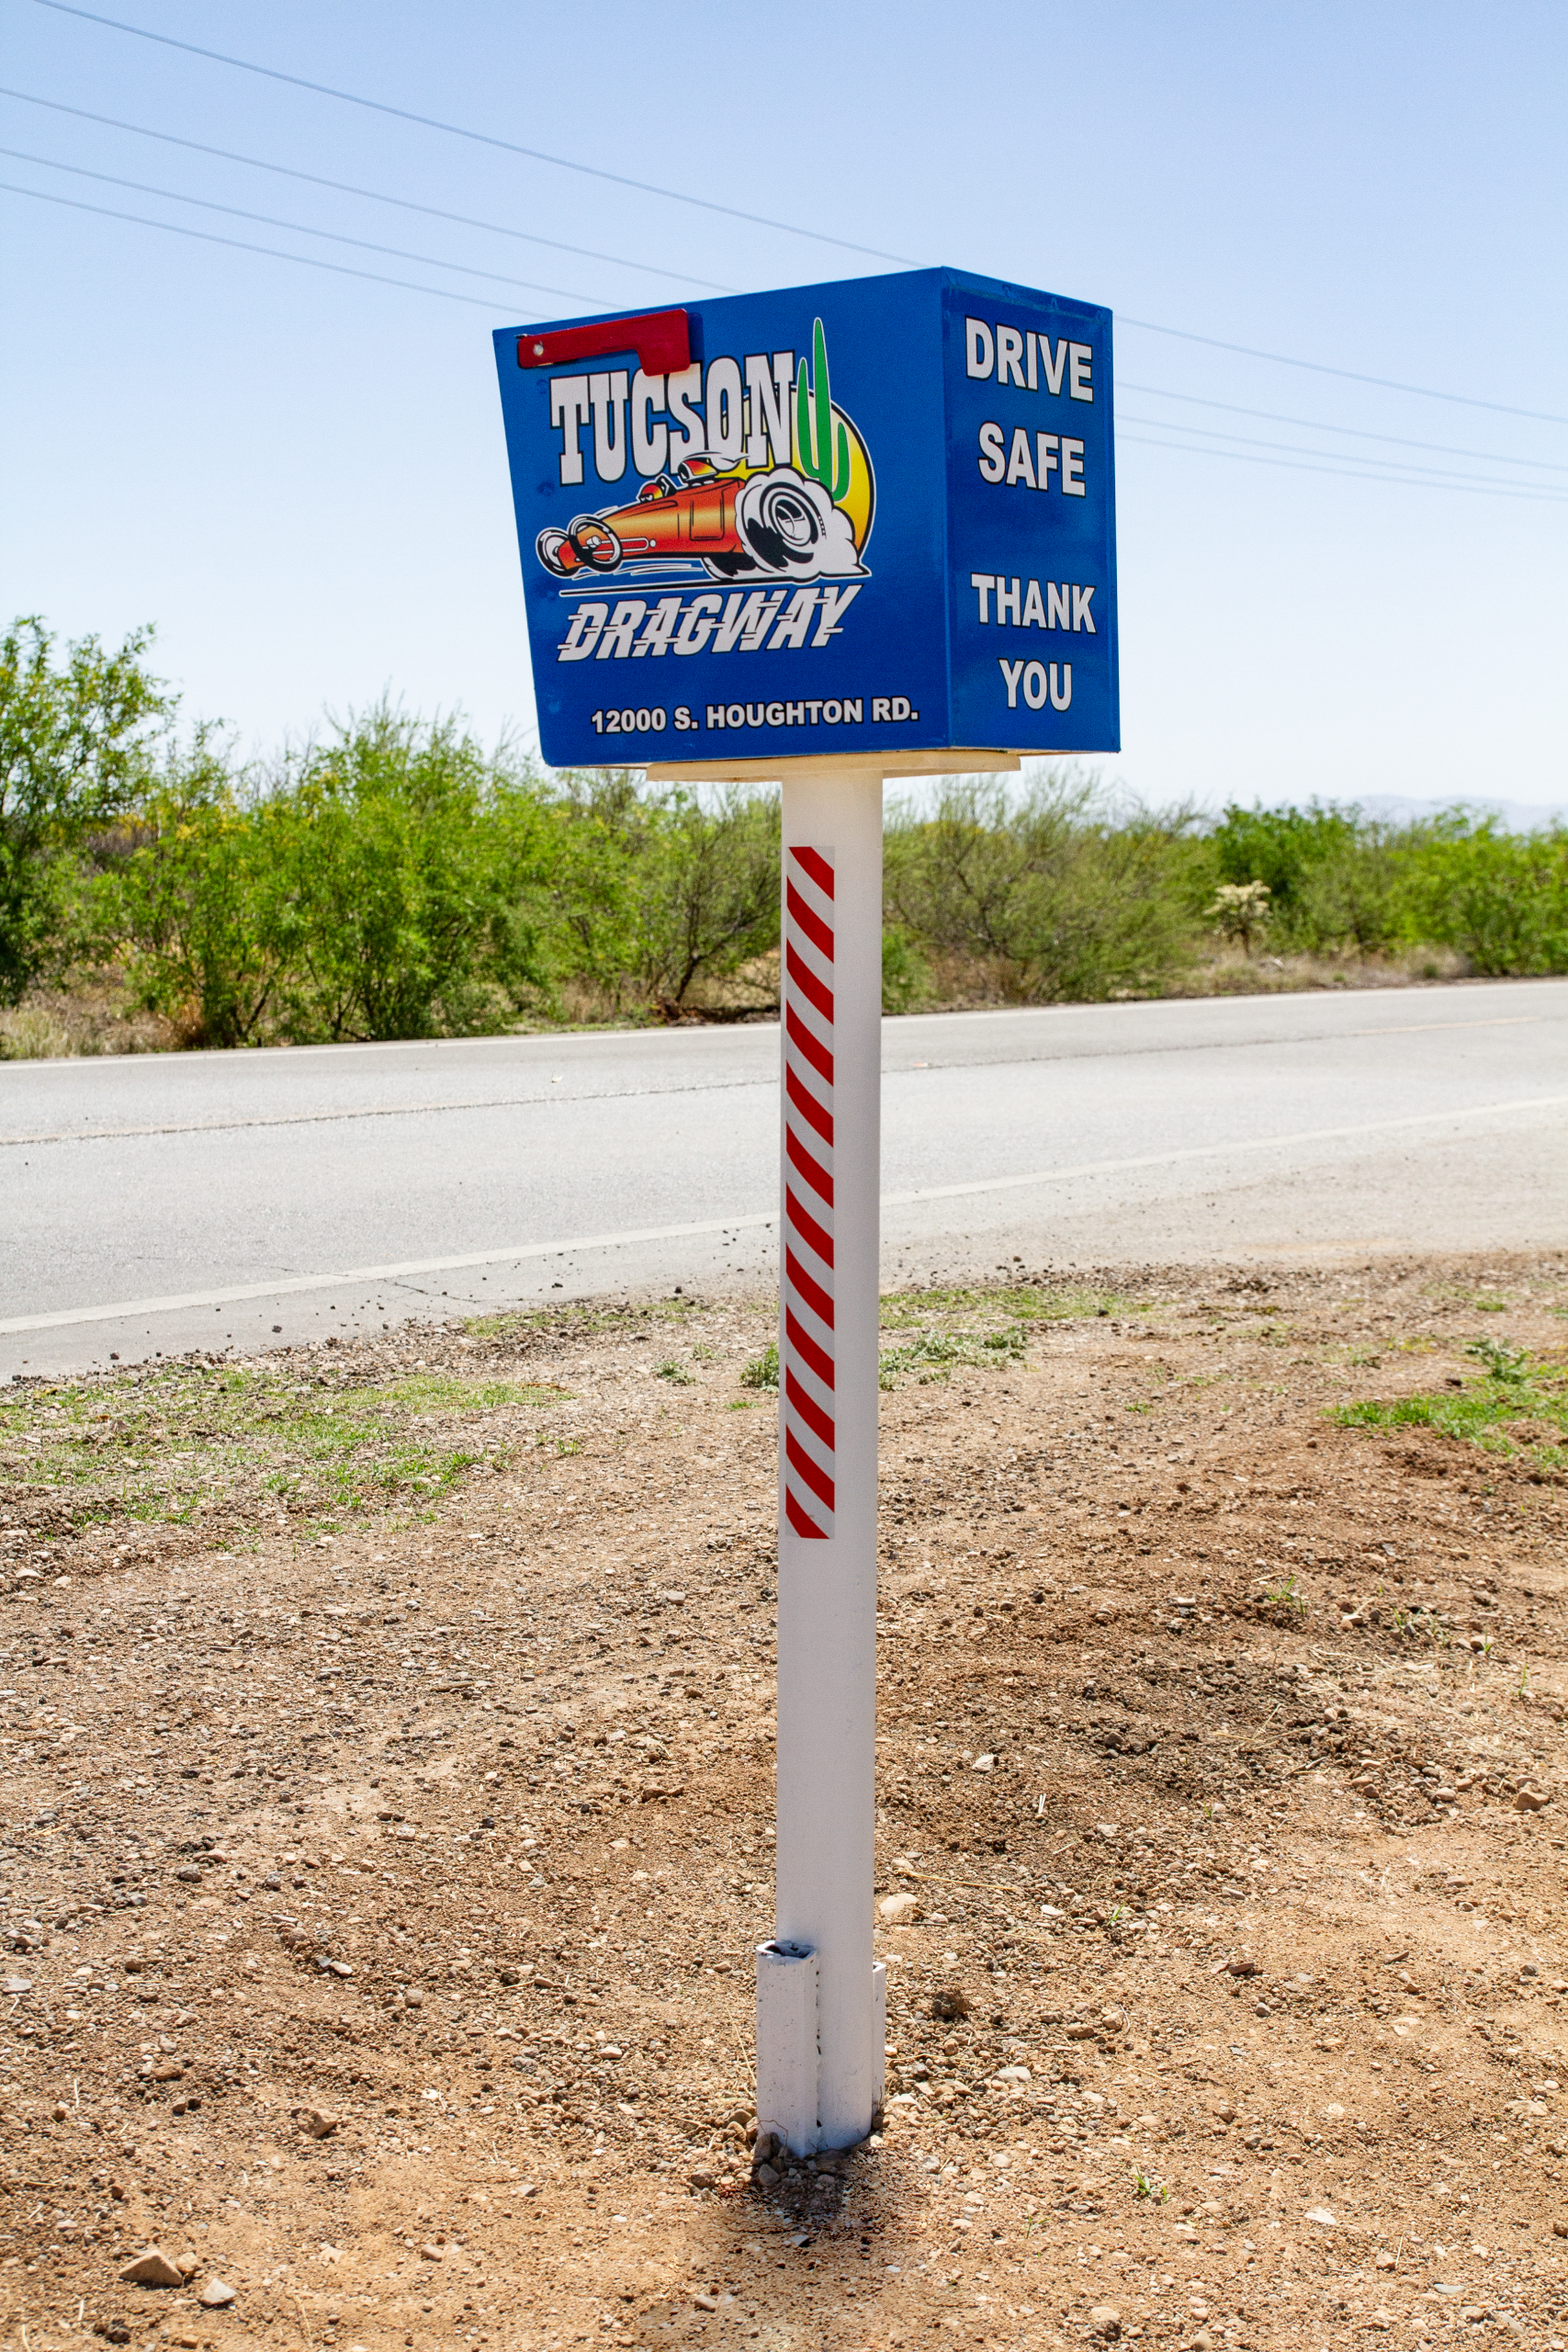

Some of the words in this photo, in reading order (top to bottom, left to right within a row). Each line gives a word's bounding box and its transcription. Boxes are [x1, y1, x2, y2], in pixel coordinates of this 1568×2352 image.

[965, 317, 1093, 401] DRIVE
[550, 351, 795, 484] TUCSON
[978, 423, 1086, 496] SAFE
[558, 585, 862, 661] DRAGWAY
[971, 573, 1097, 633] THANK
[592, 707, 666, 733] 12000
[673, 707, 698, 729] S.
[706, 699, 863, 729] HOUGHTON
[873, 697, 919, 721] RD.
[998, 659, 1072, 711] YOU
